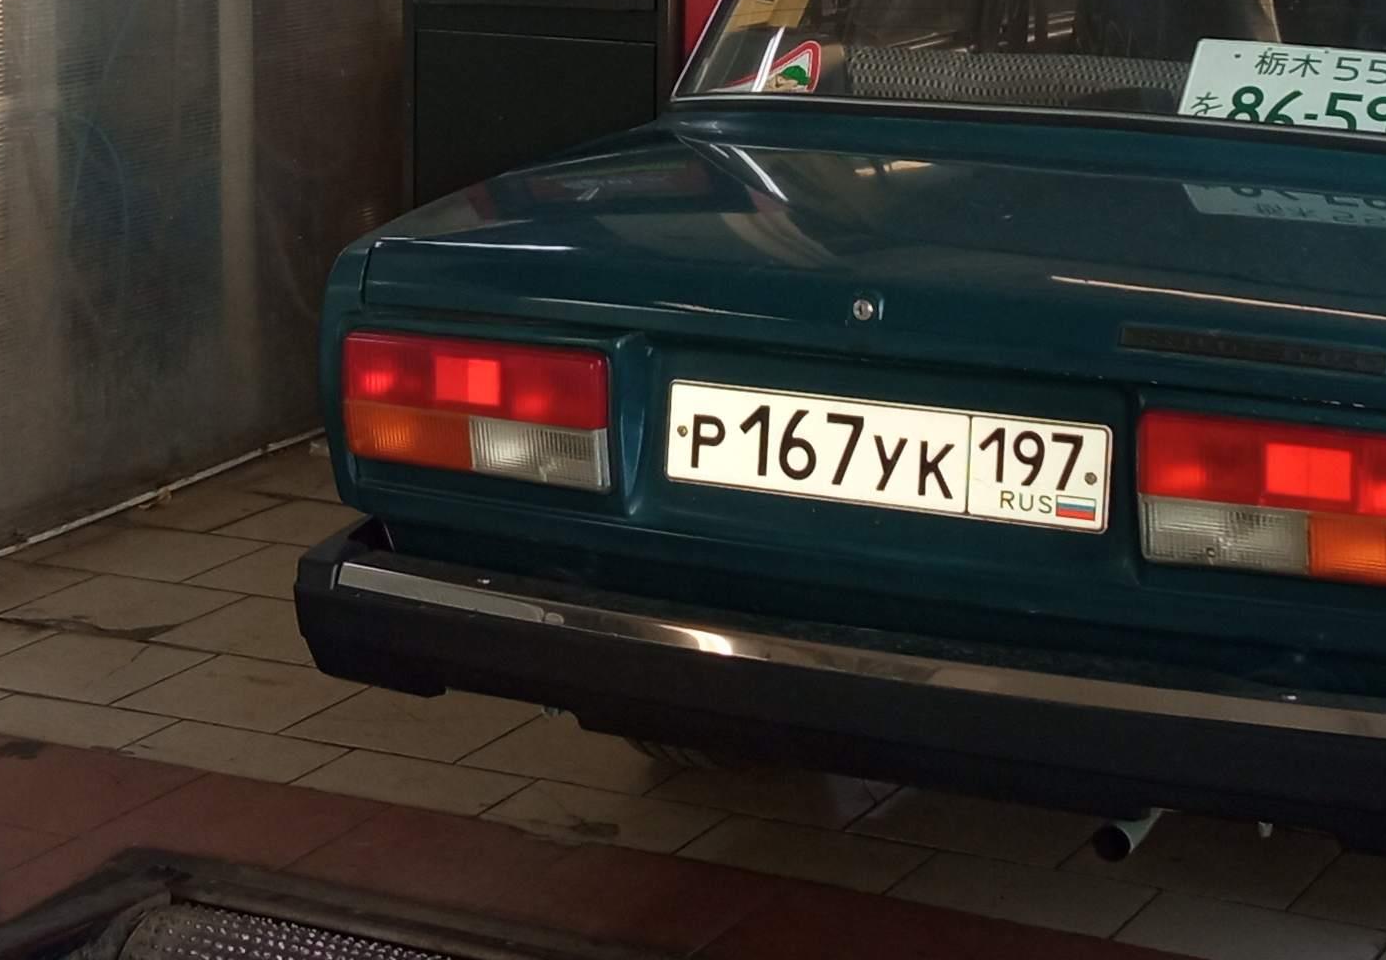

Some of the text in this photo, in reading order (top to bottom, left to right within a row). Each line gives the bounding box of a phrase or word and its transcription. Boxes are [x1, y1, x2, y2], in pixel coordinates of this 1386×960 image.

[1254, 51, 1323, 78] 栃木
[978, 427, 1085, 492] 197
[999, 490, 1054, 515] RUS
